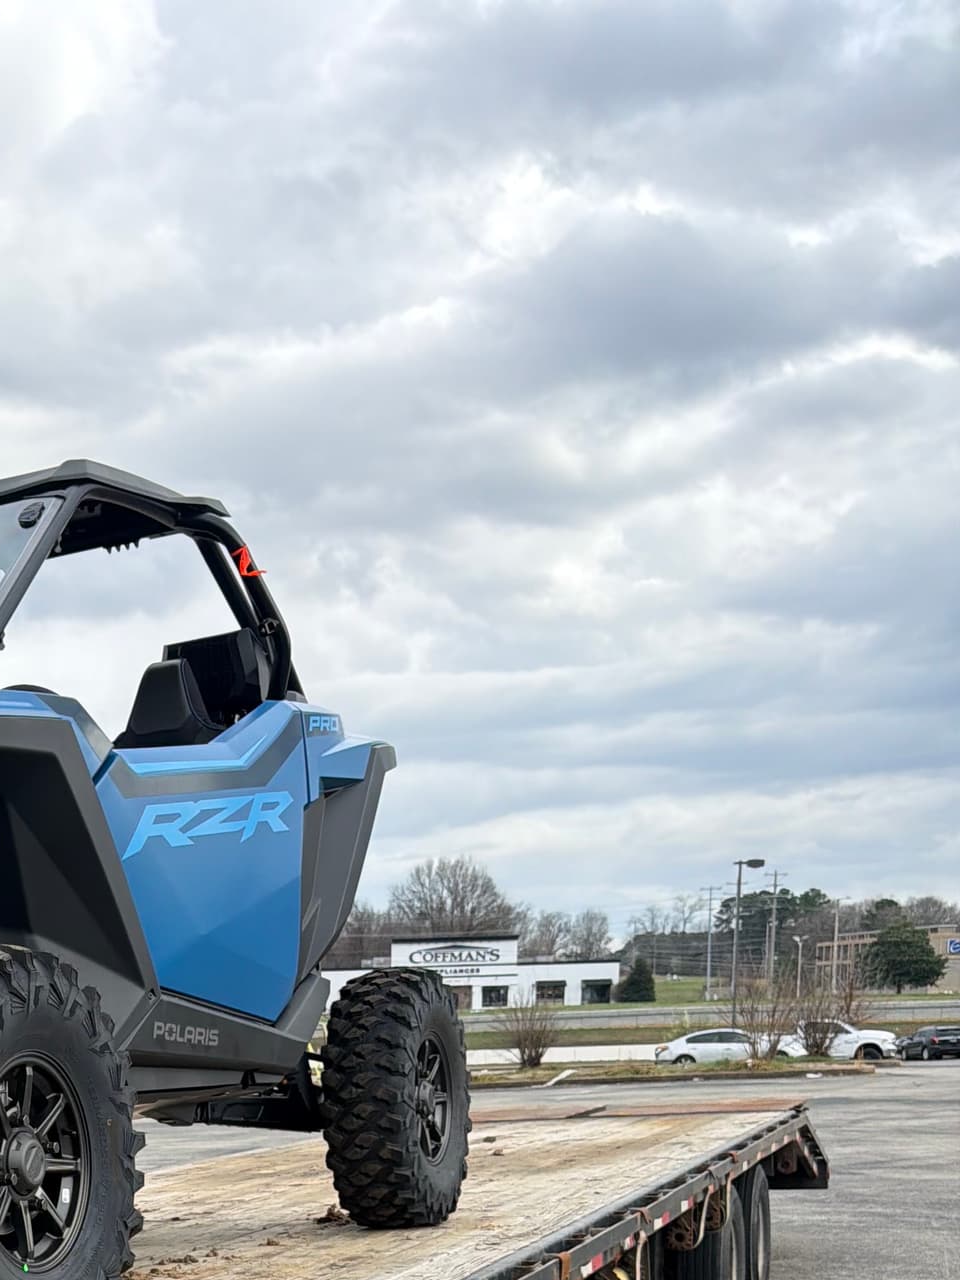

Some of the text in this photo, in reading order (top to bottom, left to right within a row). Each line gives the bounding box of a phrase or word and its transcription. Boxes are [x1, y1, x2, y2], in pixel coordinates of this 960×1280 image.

[309, 715, 339, 732] PRO
[121, 791, 293, 862] RZR
[408, 948, 501, 965] COFFMAN'S
[436, 967, 481, 975] PLIANCES
[153, 1021, 219, 1046] POLARIS
